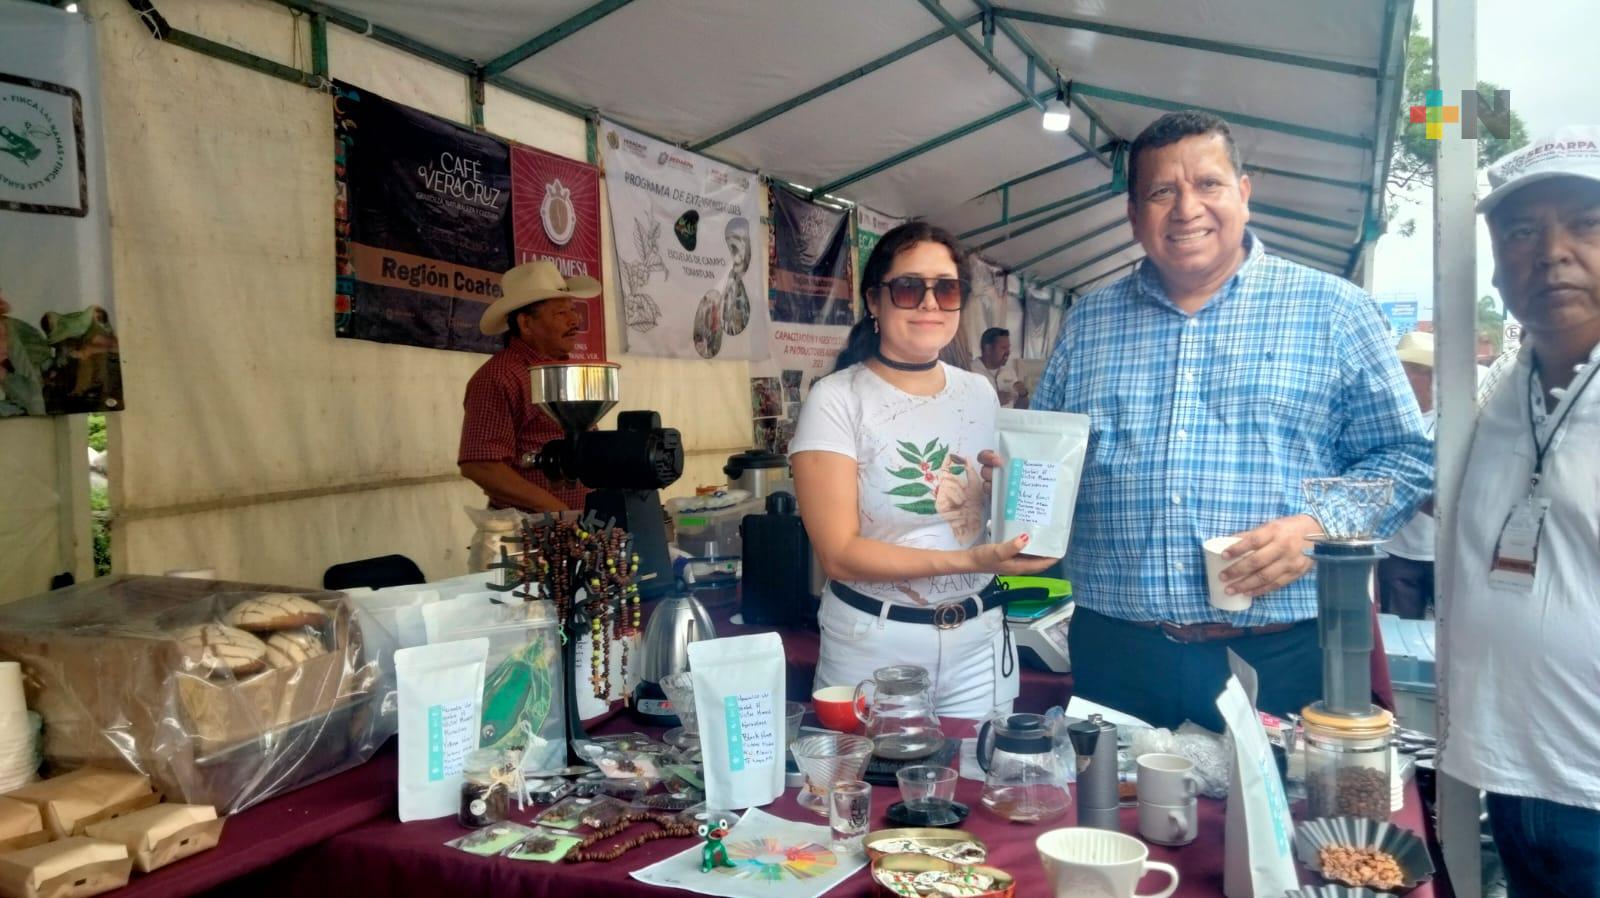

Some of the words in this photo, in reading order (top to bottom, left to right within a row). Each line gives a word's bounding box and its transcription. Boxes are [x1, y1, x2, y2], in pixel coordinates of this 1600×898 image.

[10, 95, 39, 111] FINCA
[1527, 141, 1597, 157] SEDARPA
[440, 152, 482, 183] CAFÉ
[418, 166, 501, 209] VERACRUZ
[624, 171, 670, 198] PROGRAMA
[672, 188, 686, 203] DE
[381, 256, 449, 288] Región
[453, 271, 505, 298] Coate
